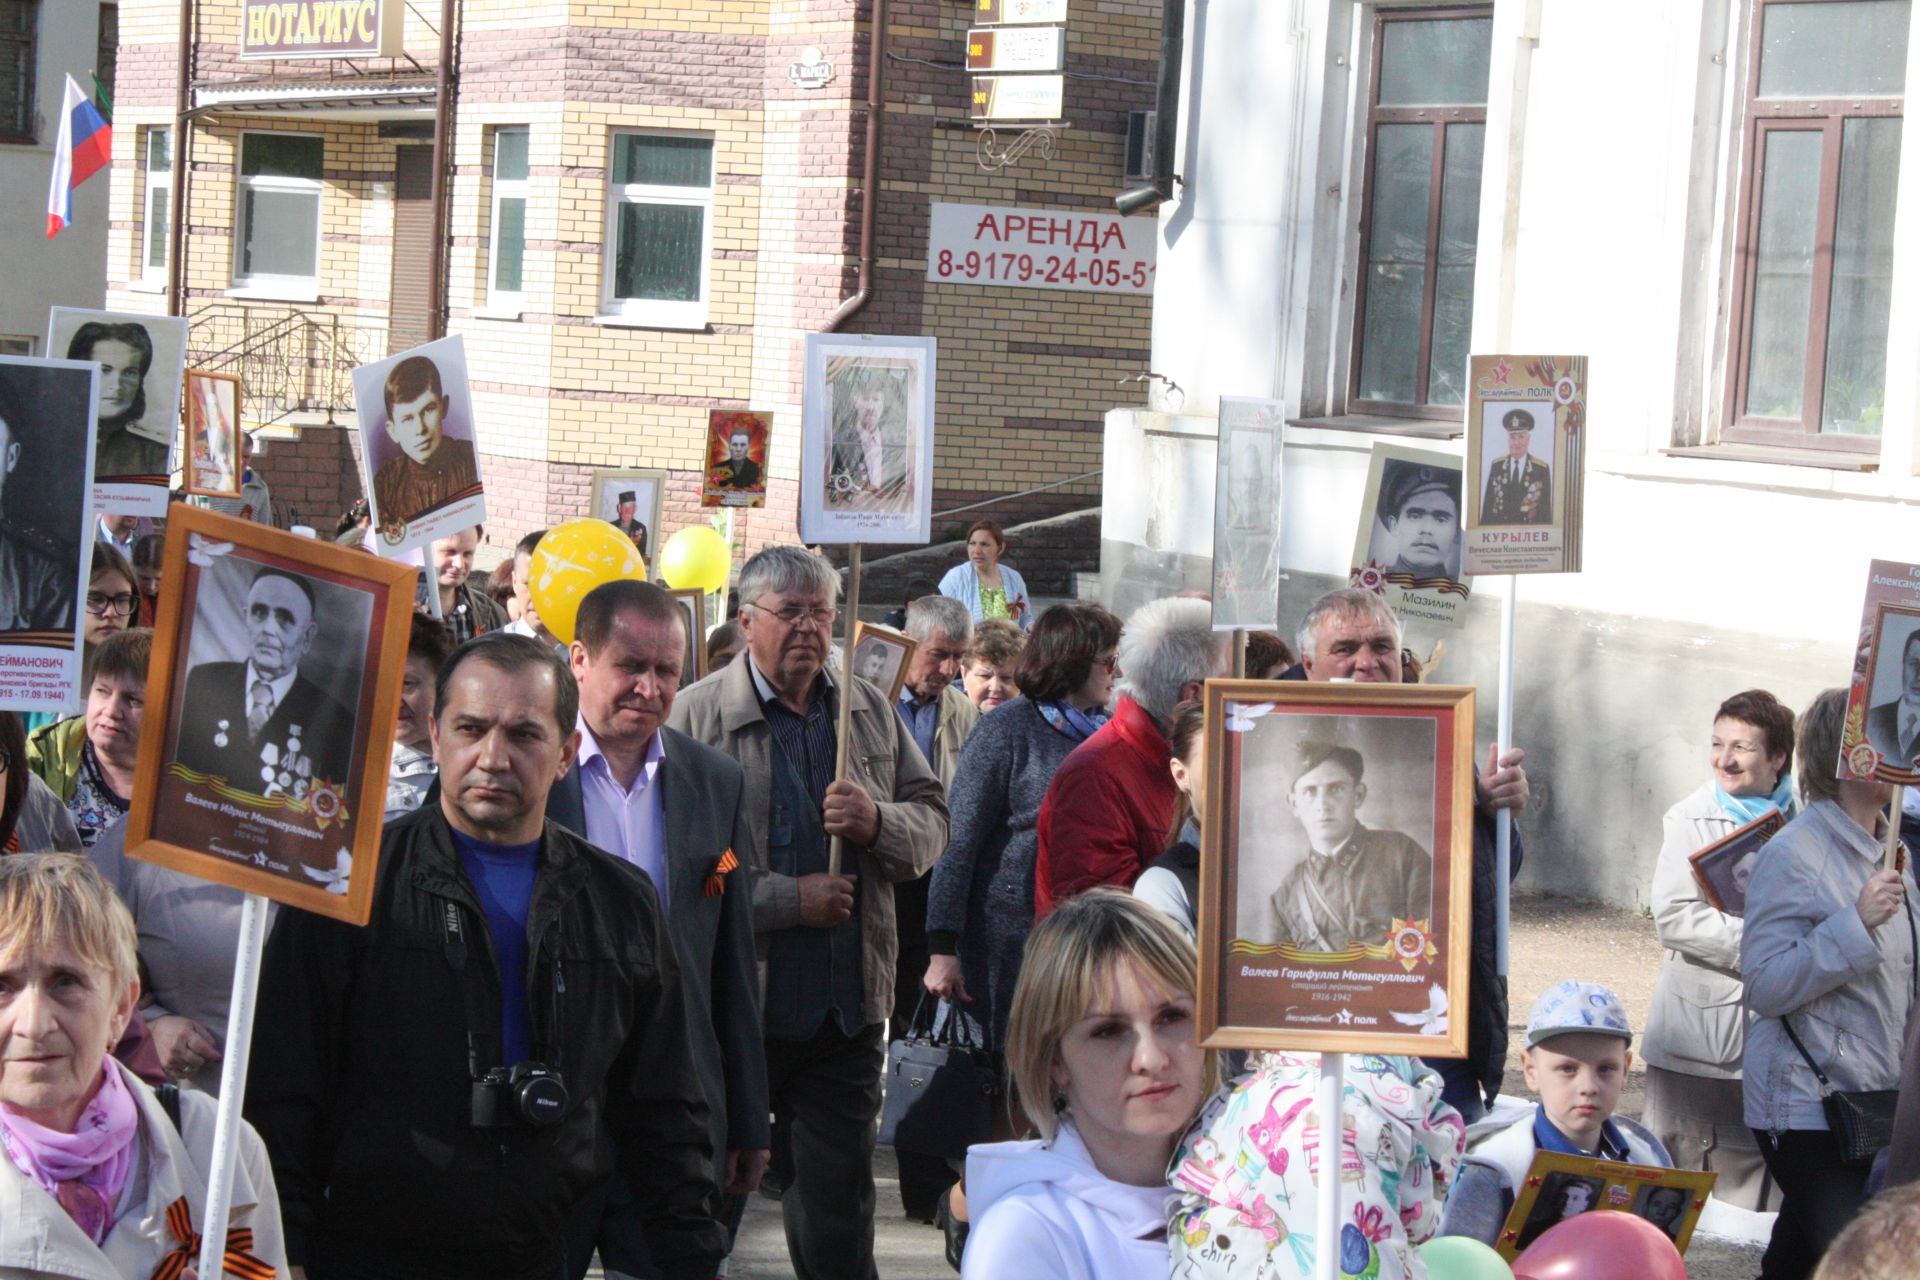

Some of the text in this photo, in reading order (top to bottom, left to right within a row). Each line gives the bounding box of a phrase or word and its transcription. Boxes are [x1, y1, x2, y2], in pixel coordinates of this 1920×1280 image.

[246, 0, 376, 46] НОТАРИУС
[974, 213, 1126, 254] АРЕНДА
[1527, 387, 1552, 397] ПОЛК
[1482, 532, 1549, 543] КУРЫЛЕВ
[1503, 545, 1562, 554] Константинович
[1402, 592, 1456, 611] Мазилин
[1400, 606, 1454, 622] Николаевич
[185, 792, 324, 841] Валеев Идрис Мотыгуллович
[1241, 965, 1425, 983] Валеев Гарифулла Мотыгуллович
[537, 1098, 558, 1106] Nikon
[1200, 1240, 1237, 1273] chirp
